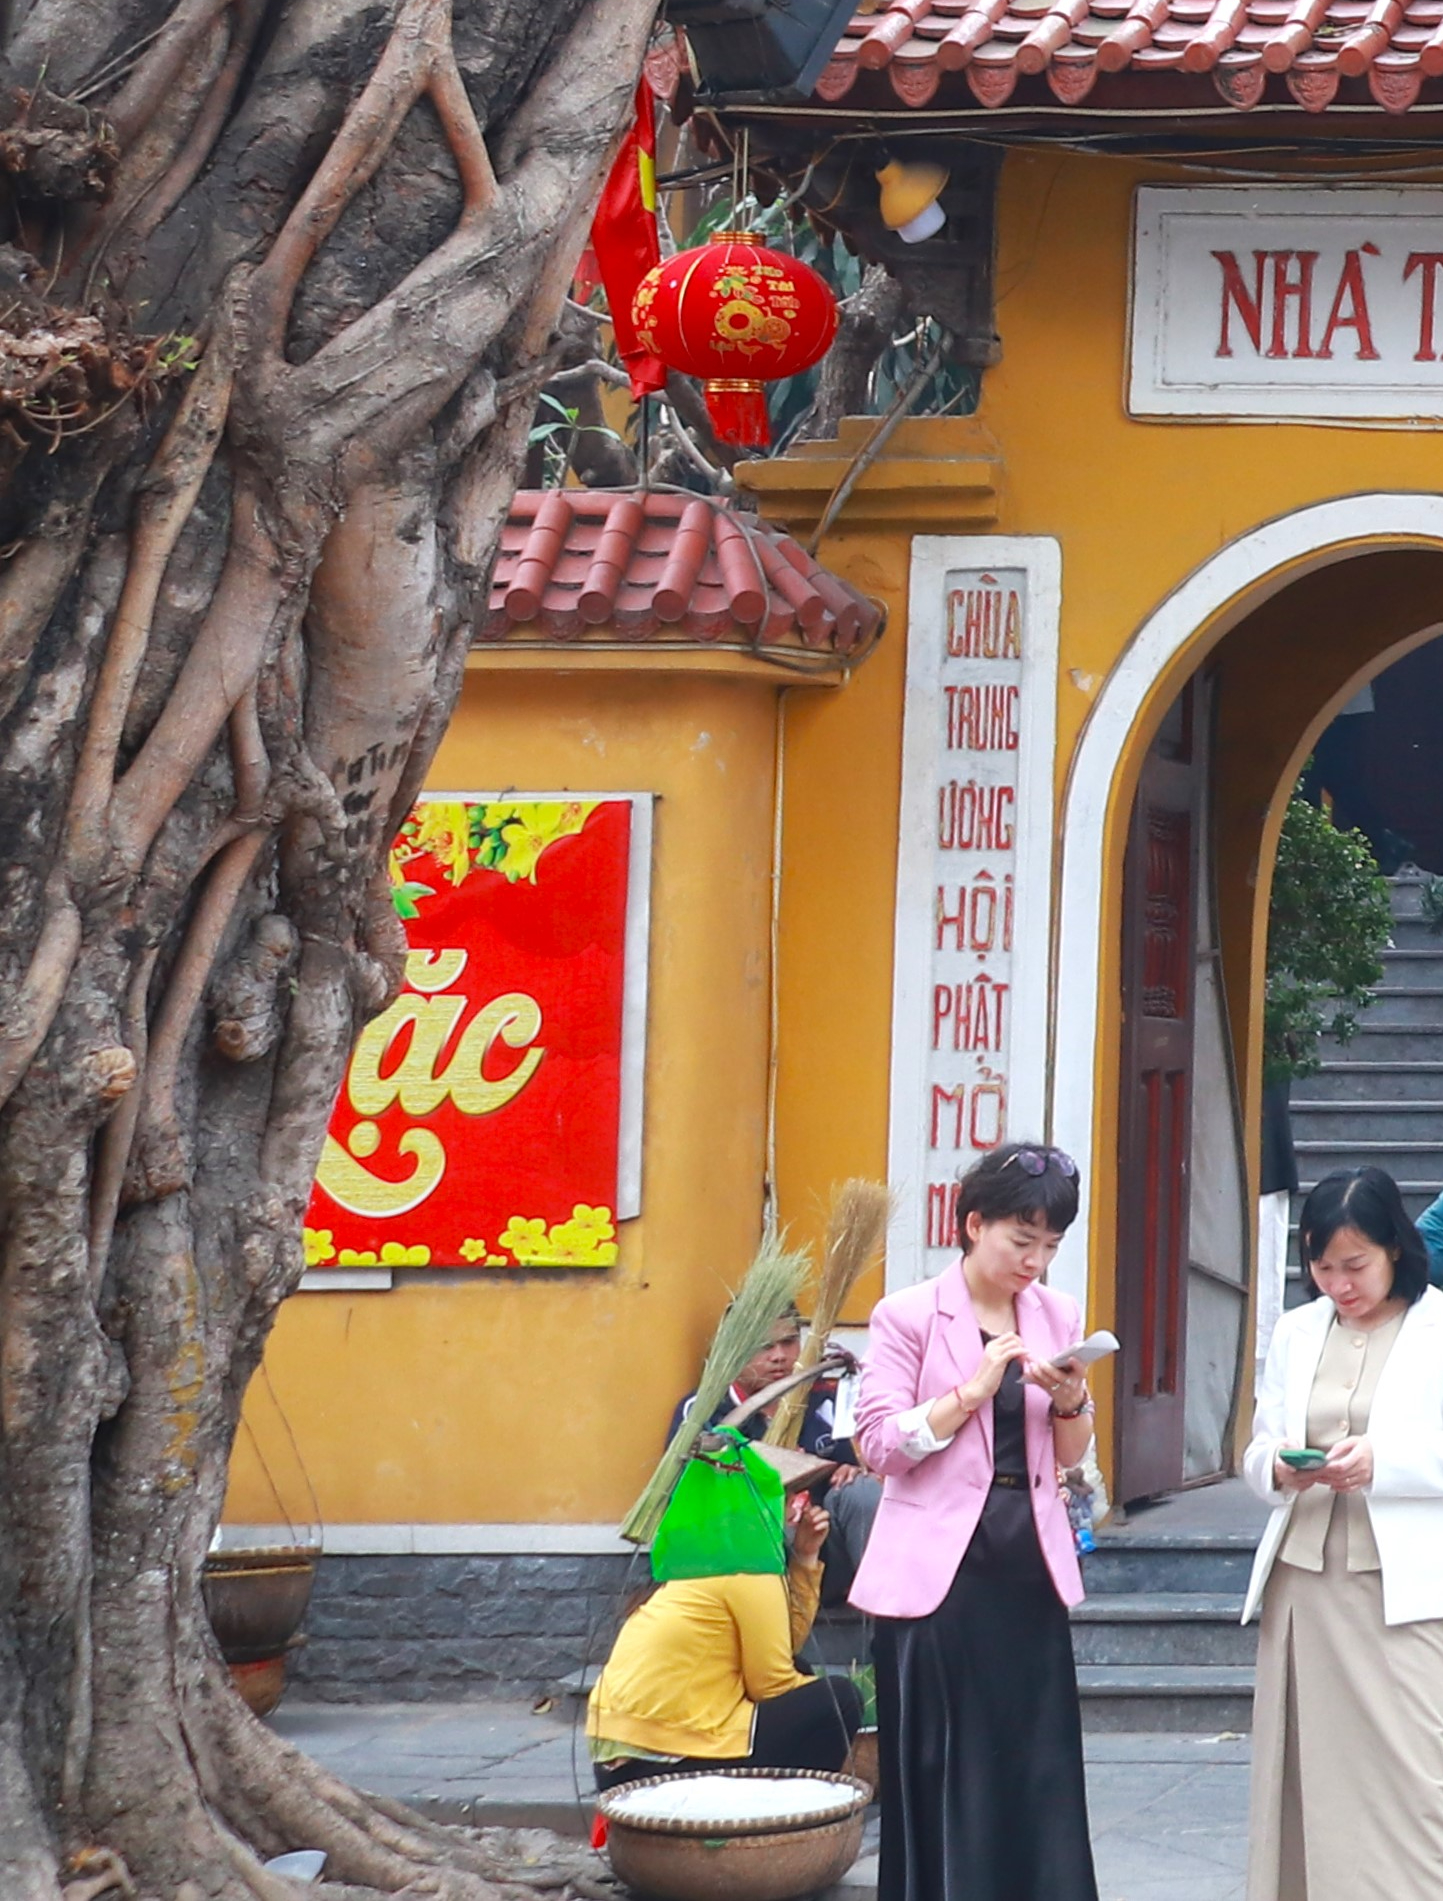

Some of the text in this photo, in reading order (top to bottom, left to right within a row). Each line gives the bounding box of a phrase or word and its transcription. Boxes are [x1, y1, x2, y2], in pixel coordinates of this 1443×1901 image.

[1209, 241, 1381, 361] NHÀ
[945, 573, 1023, 660] CHÙA
[944, 684, 1020, 751] TRUNG
[938, 778, 1015, 852] ƯƠNG
[935, 869, 1014, 962] HỘI
[931, 973, 1010, 1065] PHẬT
